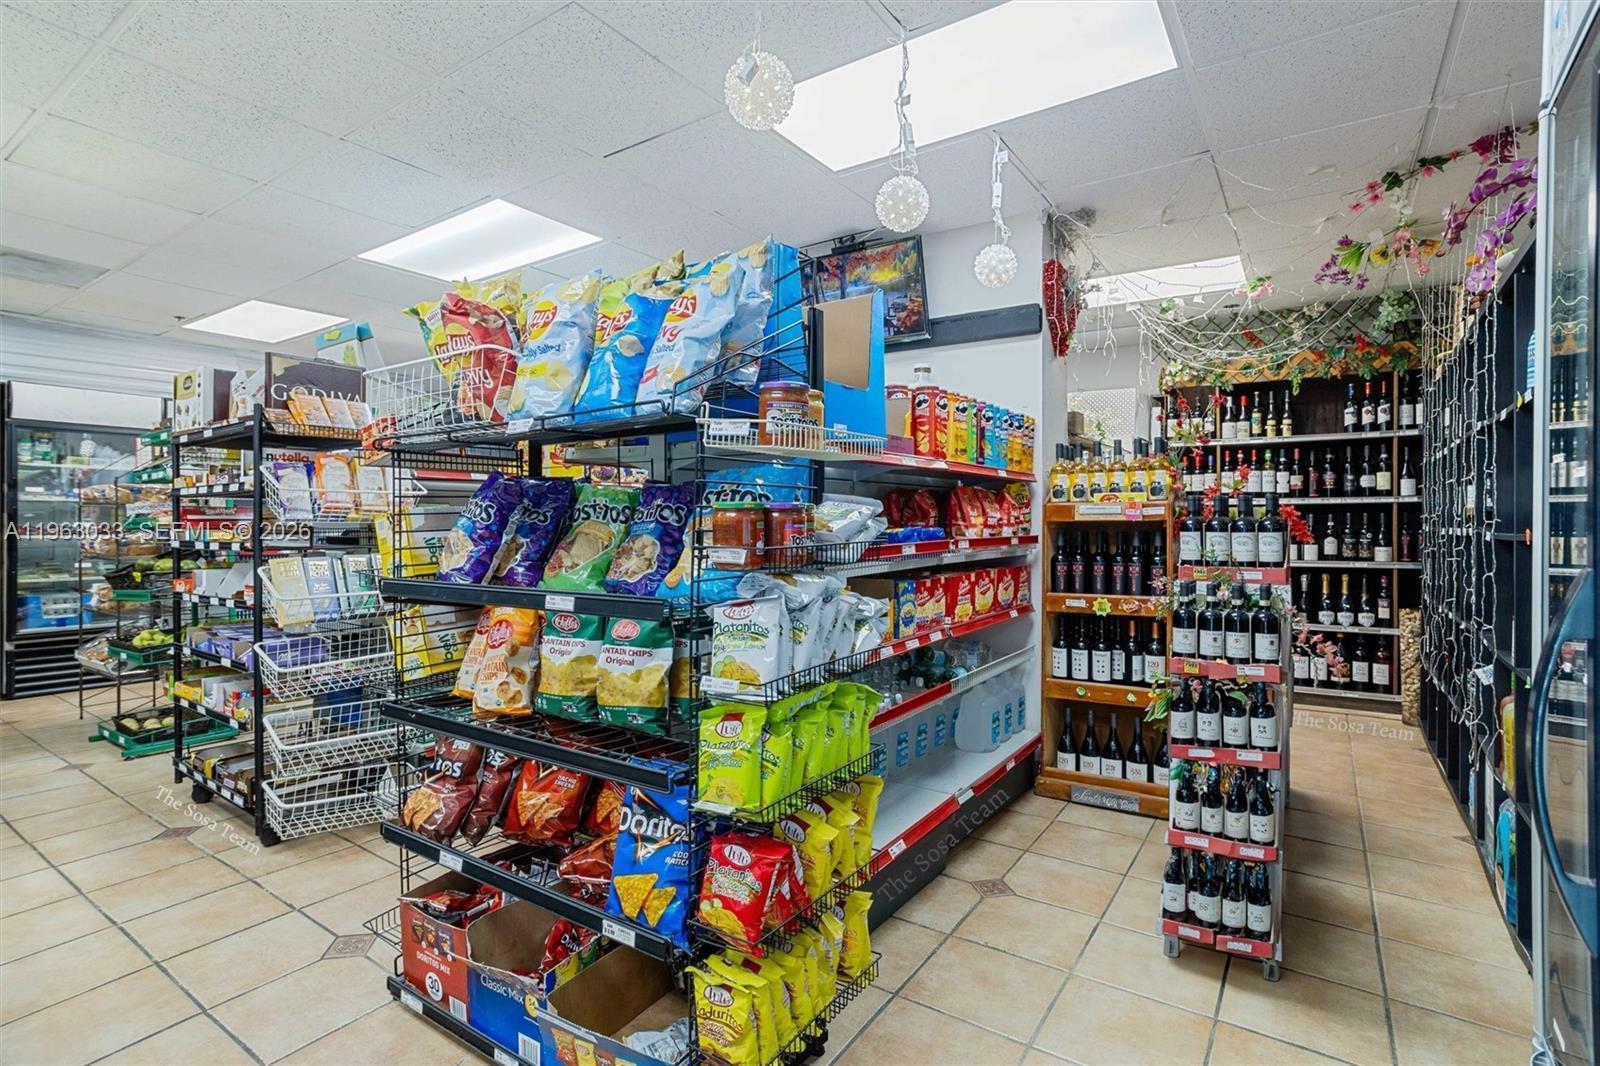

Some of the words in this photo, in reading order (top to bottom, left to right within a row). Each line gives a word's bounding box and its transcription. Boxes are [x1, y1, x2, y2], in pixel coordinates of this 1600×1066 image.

[713, 619, 770, 635] Platanitos
[627, 649, 653, 657] CHIPS
[605, 656, 635, 667] Original
[440, 963, 450, 976] MIX
[428, 975, 440, 993] 30
[481, 974, 508, 997] Classic
[508, 988, 525, 1006] Mix
[699, 1006, 744, 1032] aduritos
